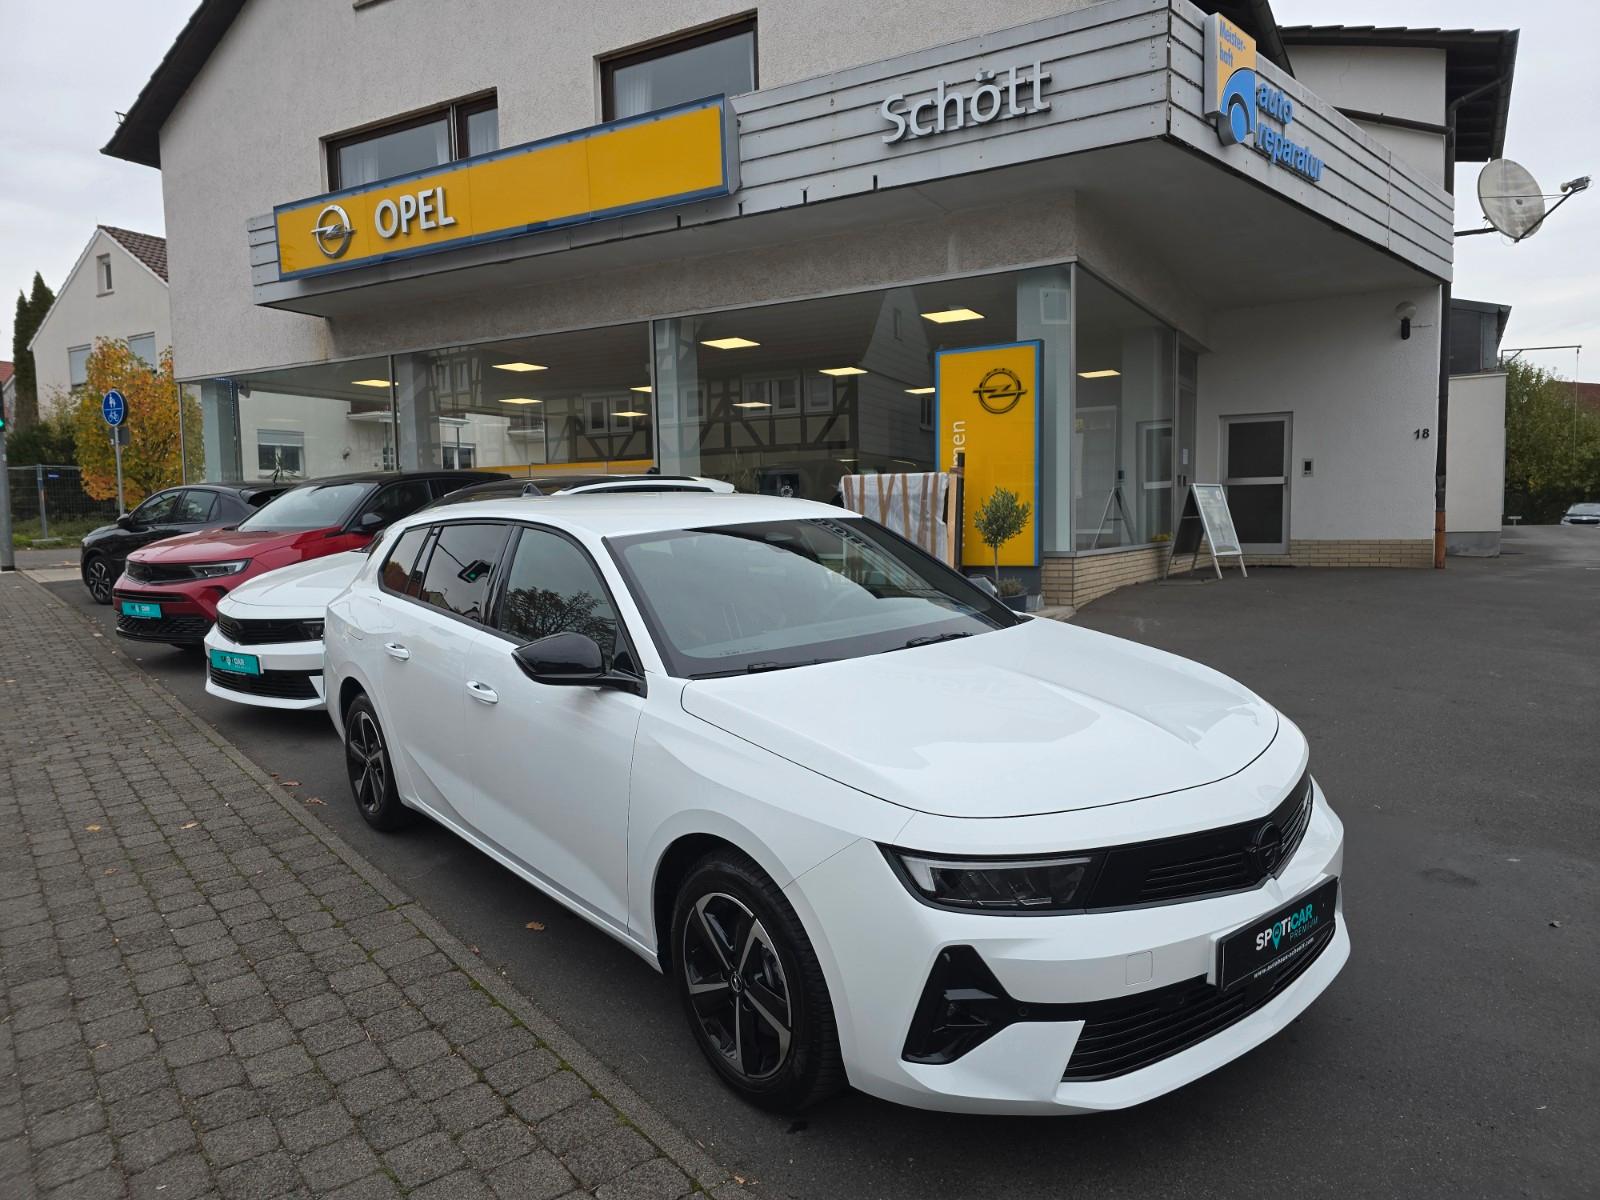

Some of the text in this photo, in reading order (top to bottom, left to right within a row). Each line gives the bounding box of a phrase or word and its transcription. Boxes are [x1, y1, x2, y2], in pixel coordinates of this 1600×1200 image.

[1220, 20, 1246, 52] Meister-
[1220, 42, 1233, 68] haft
[881, 60, 1052, 144] Schött
[1256, 82, 1294, 125] auto
[1257, 121, 1325, 183] reparatur
[375, 186, 456, 238] OPEL
[953, 420, 966, 467] men
[1413, 428, 1430, 440] 18
[1289, 915, 1318, 942] PREMIUM
